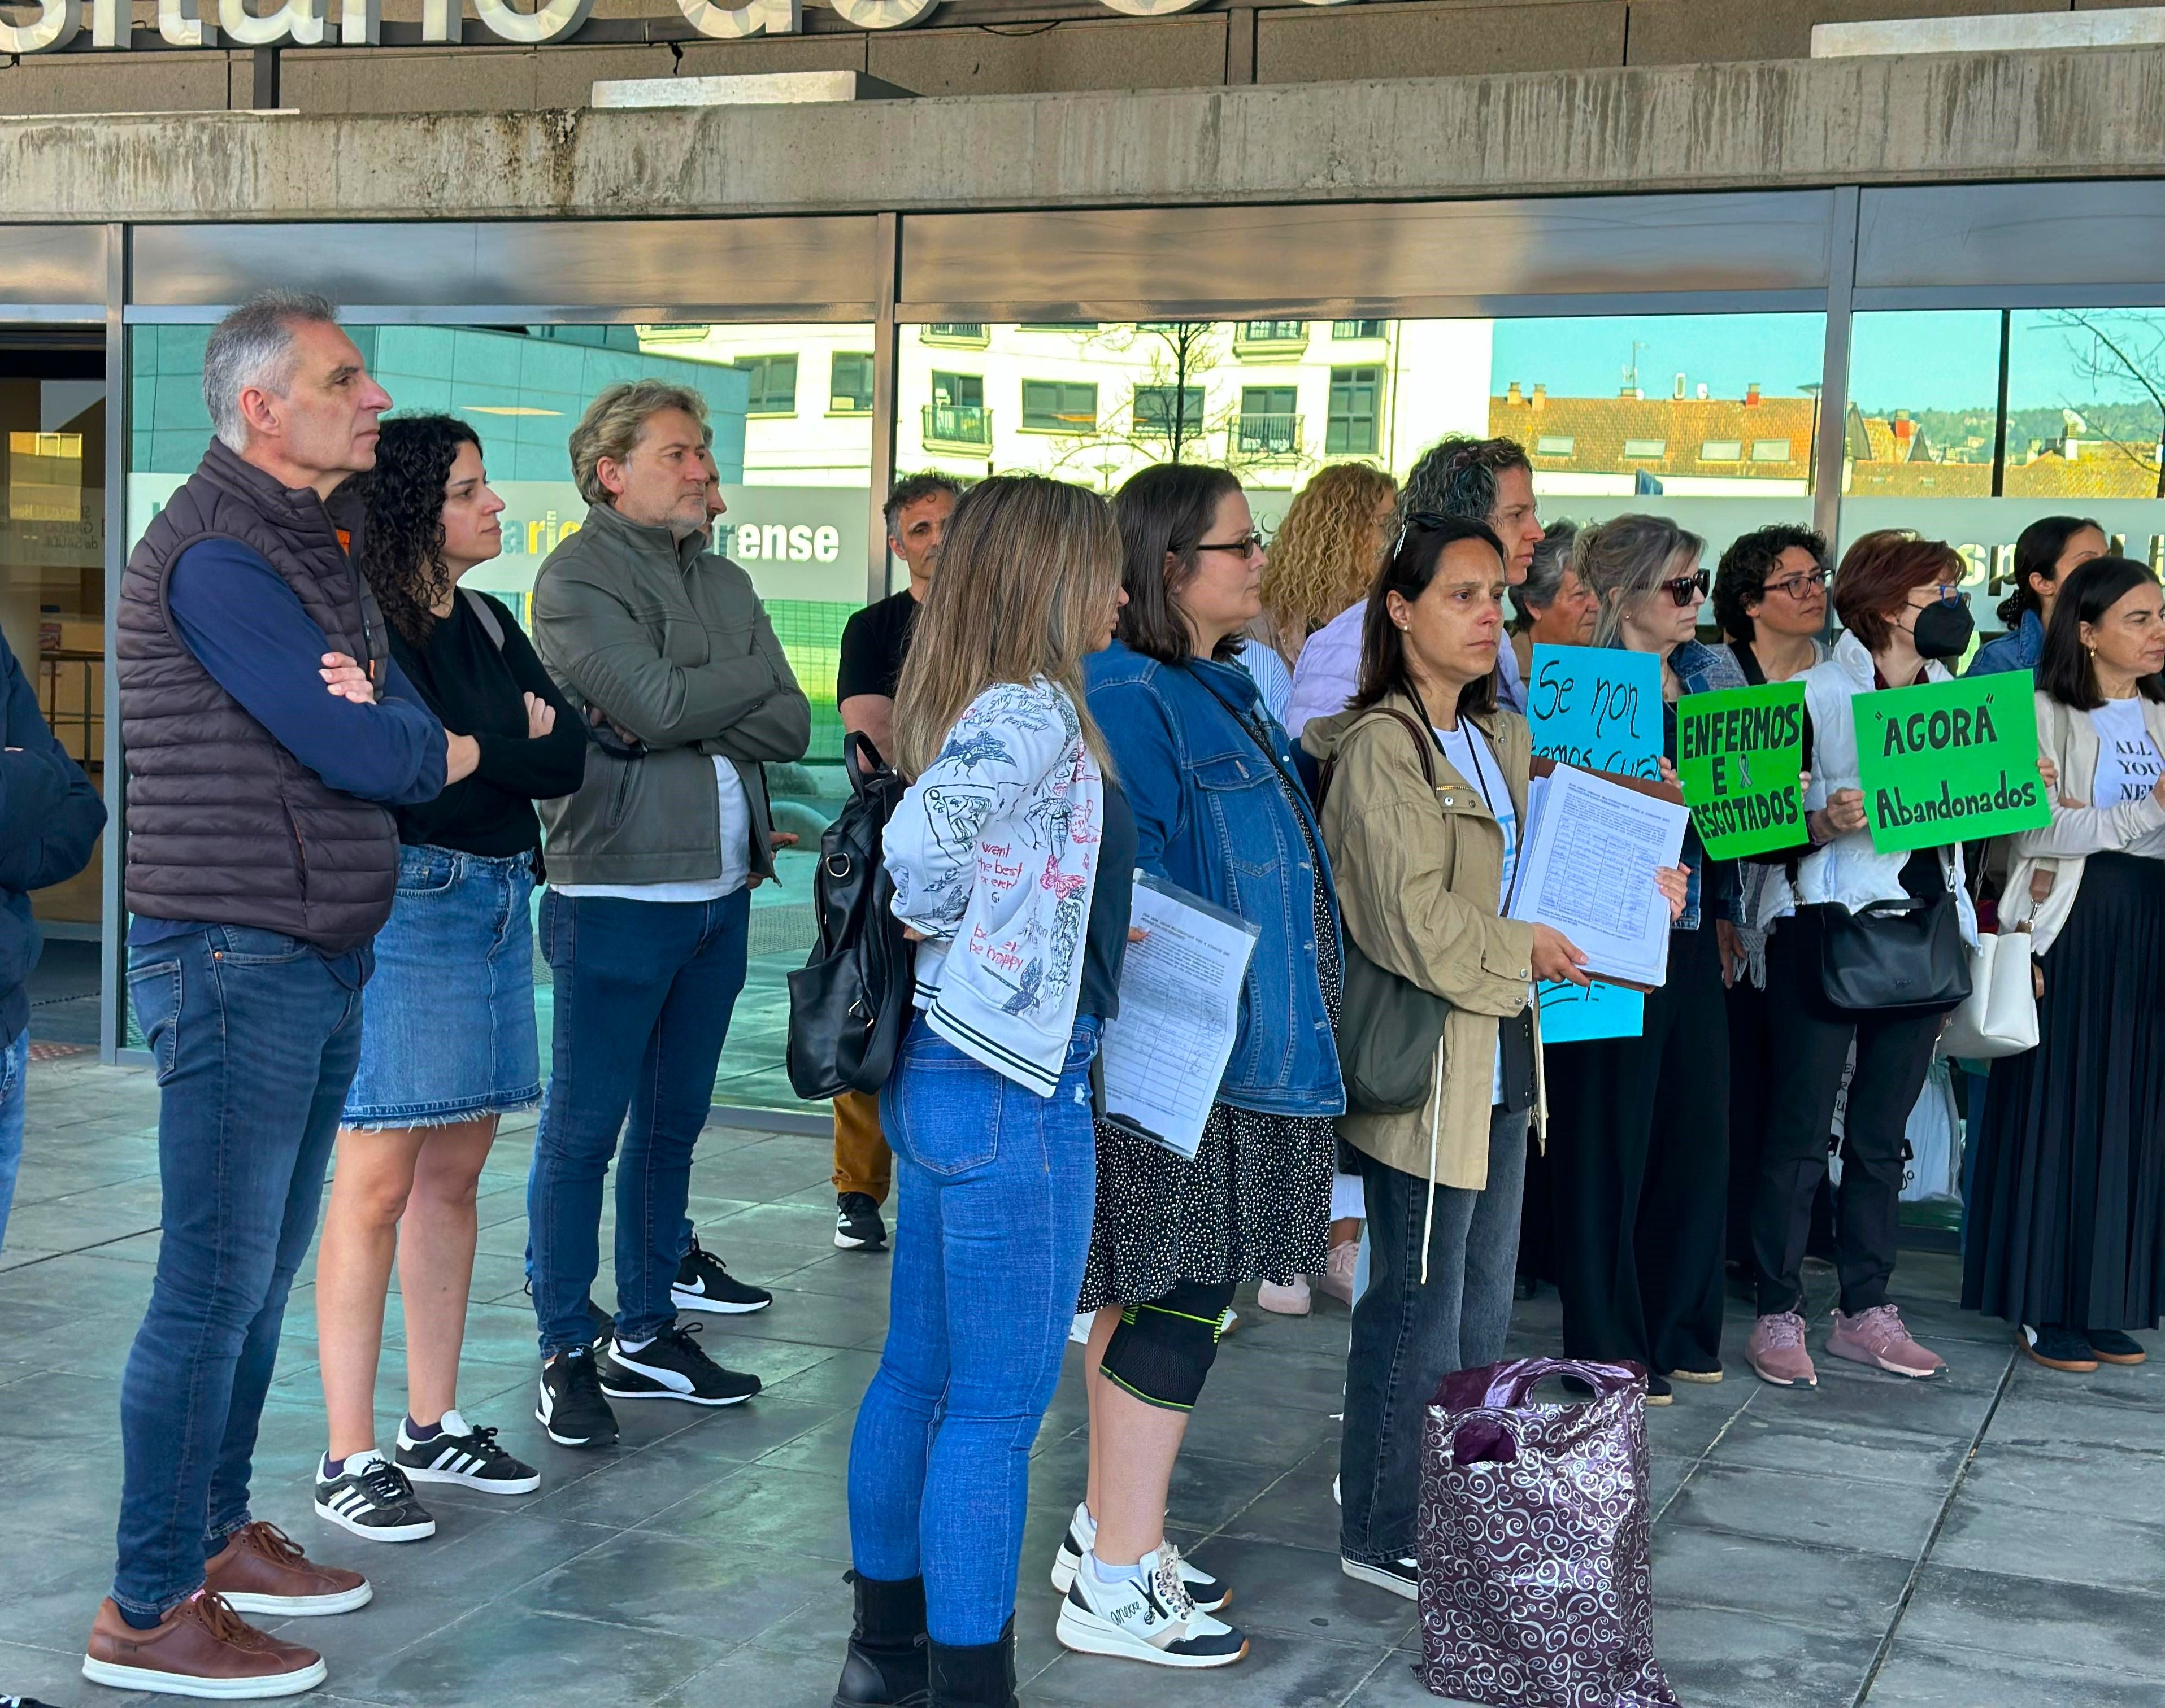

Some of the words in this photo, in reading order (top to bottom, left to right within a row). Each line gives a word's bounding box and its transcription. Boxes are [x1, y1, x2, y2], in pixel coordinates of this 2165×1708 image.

[707, 524, 839, 563] rense
[1533, 660, 1575, 721] Se
[1590, 677, 1640, 739] non
[1684, 703, 1800, 760] ENFERMOS
[2116, 740, 2153, 756] ALL
[1712, 756, 1728, 796] E
[2116, 759, 2163, 776] YOU
[1691, 785, 1798, 839] ESGOTADOS
[1876, 770, 2037, 829] Abandonados
[977, 856, 993, 872] the
[995, 858, 1023, 879] best
[982, 840, 1012, 859] want
[969, 937, 984, 955] be
[986, 944, 1024, 974] happy
